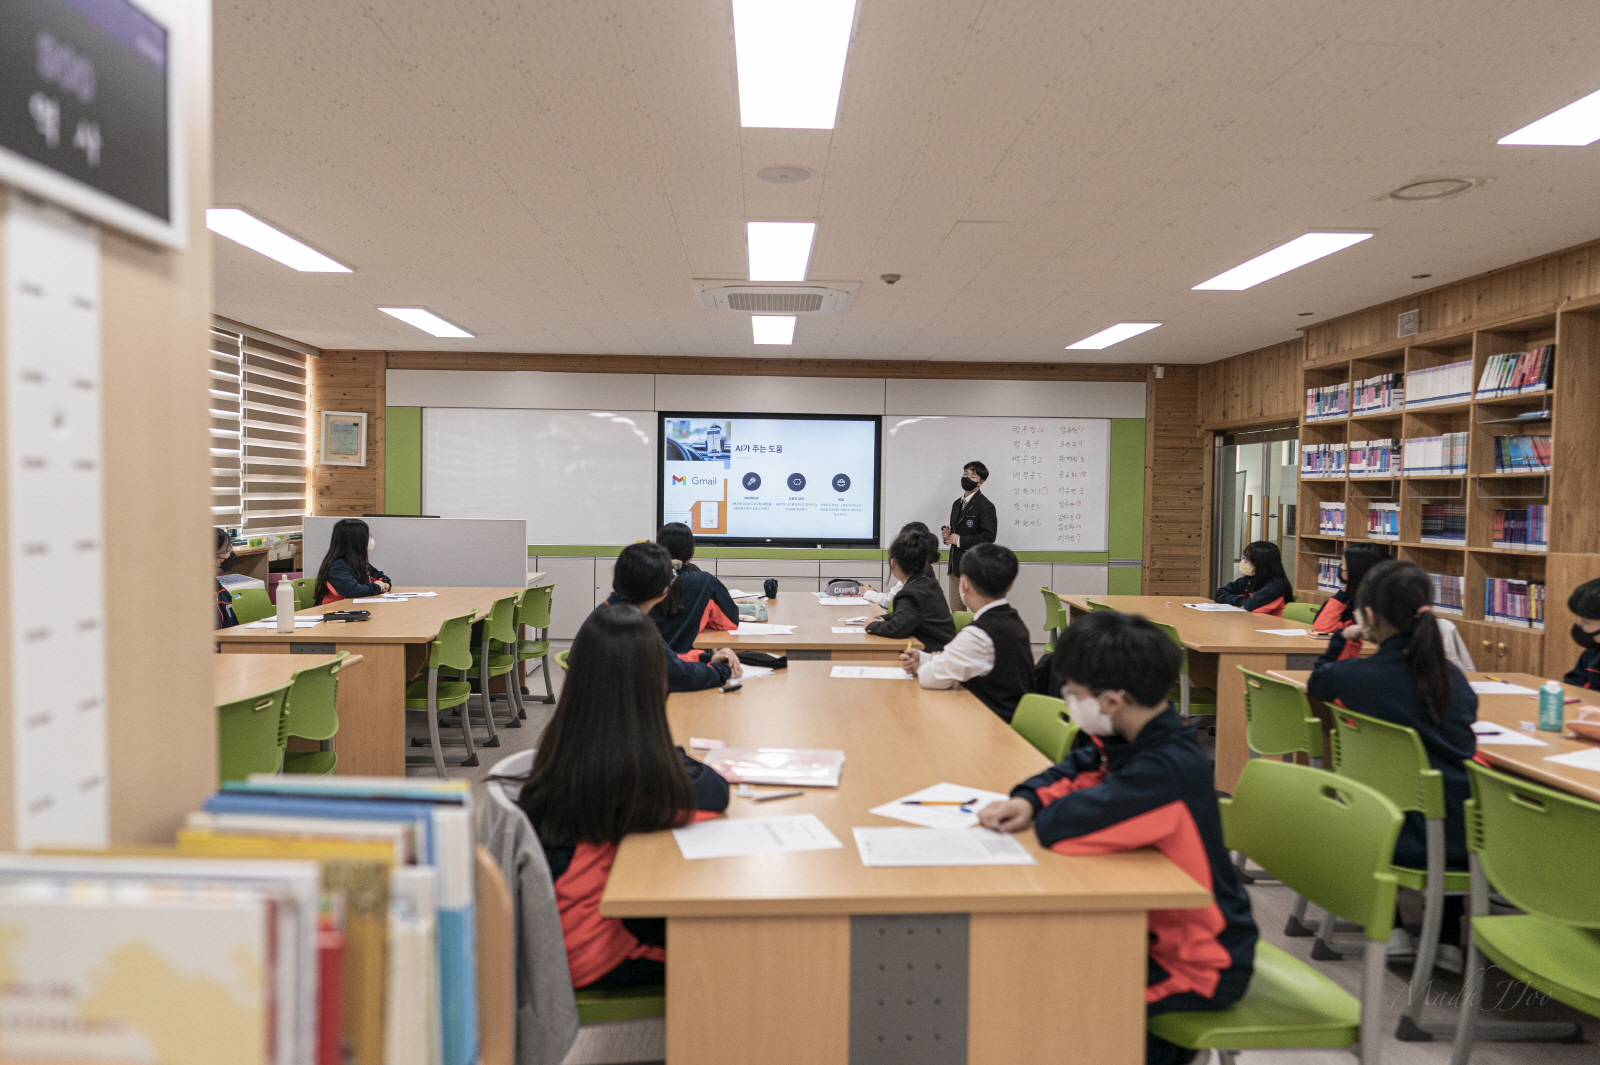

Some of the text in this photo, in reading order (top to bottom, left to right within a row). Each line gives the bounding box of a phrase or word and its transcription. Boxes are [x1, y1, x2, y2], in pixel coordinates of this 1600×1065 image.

[735, 444, 783, 454] AI가 주는 도움
[691, 476, 717, 486] Gmail
